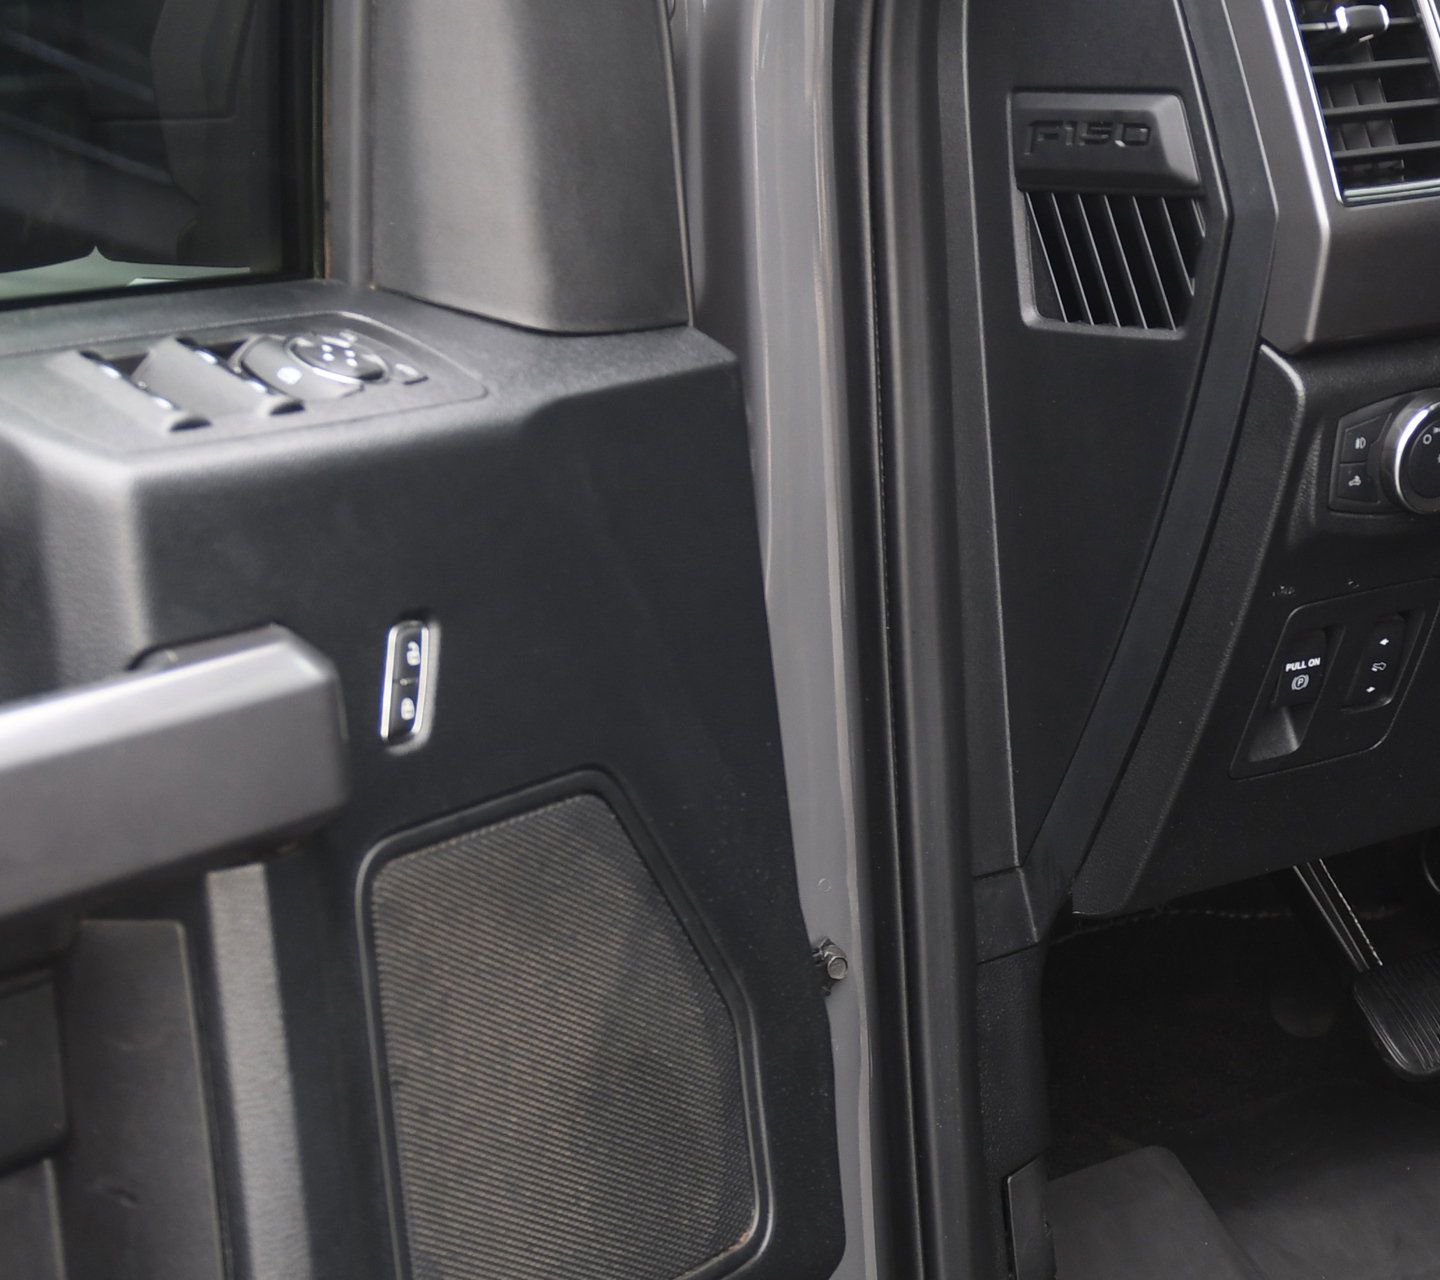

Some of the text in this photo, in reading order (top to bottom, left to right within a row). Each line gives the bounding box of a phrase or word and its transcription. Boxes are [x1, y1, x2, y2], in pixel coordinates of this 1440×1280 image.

[1024, 120, 1151, 156] F150
[1285, 657, 1321, 672] PULL ON
